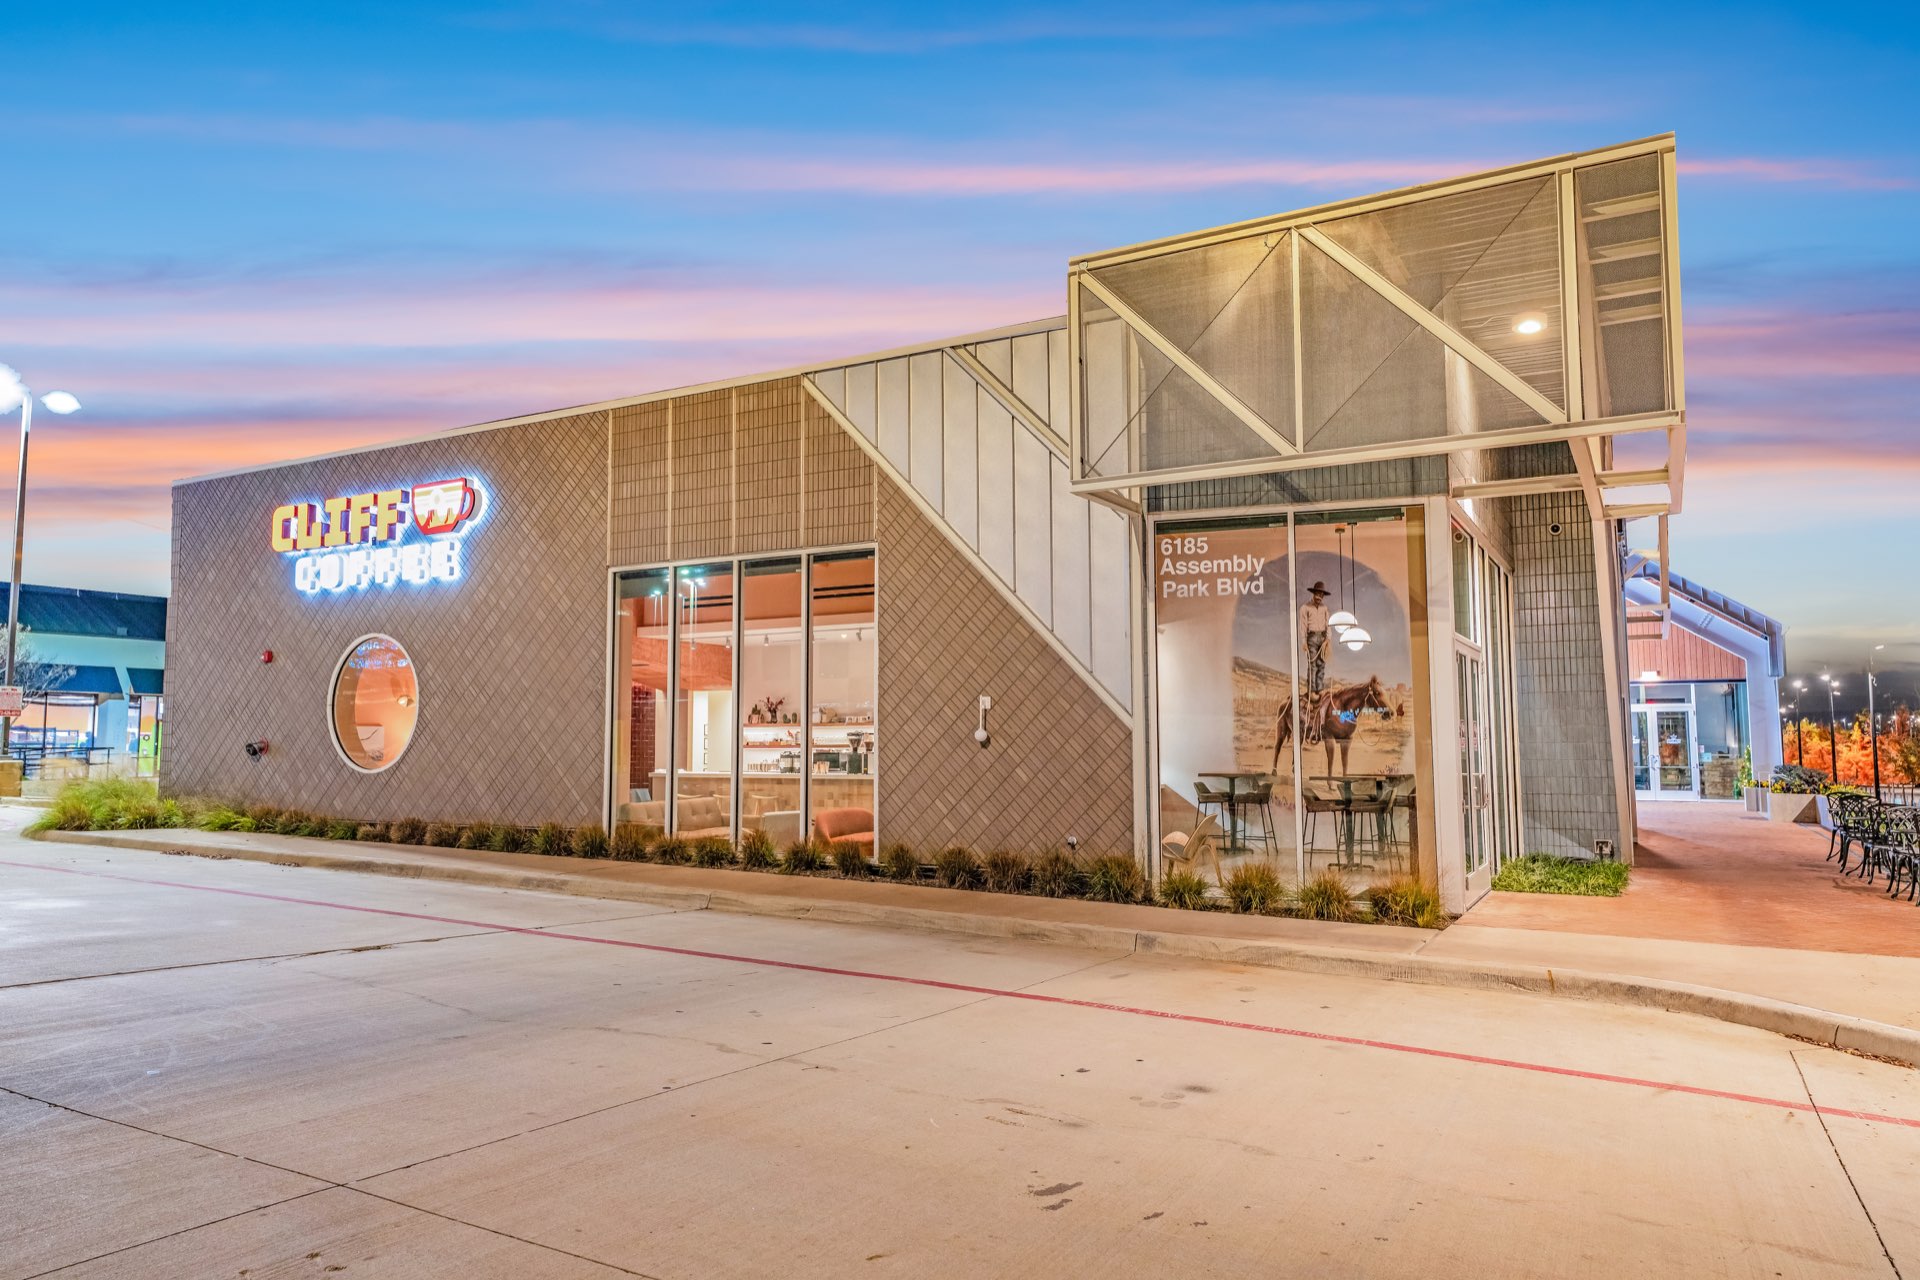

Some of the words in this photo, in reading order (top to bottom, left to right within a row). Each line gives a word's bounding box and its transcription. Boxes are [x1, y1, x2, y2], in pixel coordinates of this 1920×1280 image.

[272, 489, 410, 552] CLIFF
[1160, 537, 1209, 555] 6185
[295, 541, 460, 591] COFFEE
[1160, 554, 1265, 576] Assembly
[1163, 580, 1209, 598] Park
[1217, 577, 1264, 596] Blvd
